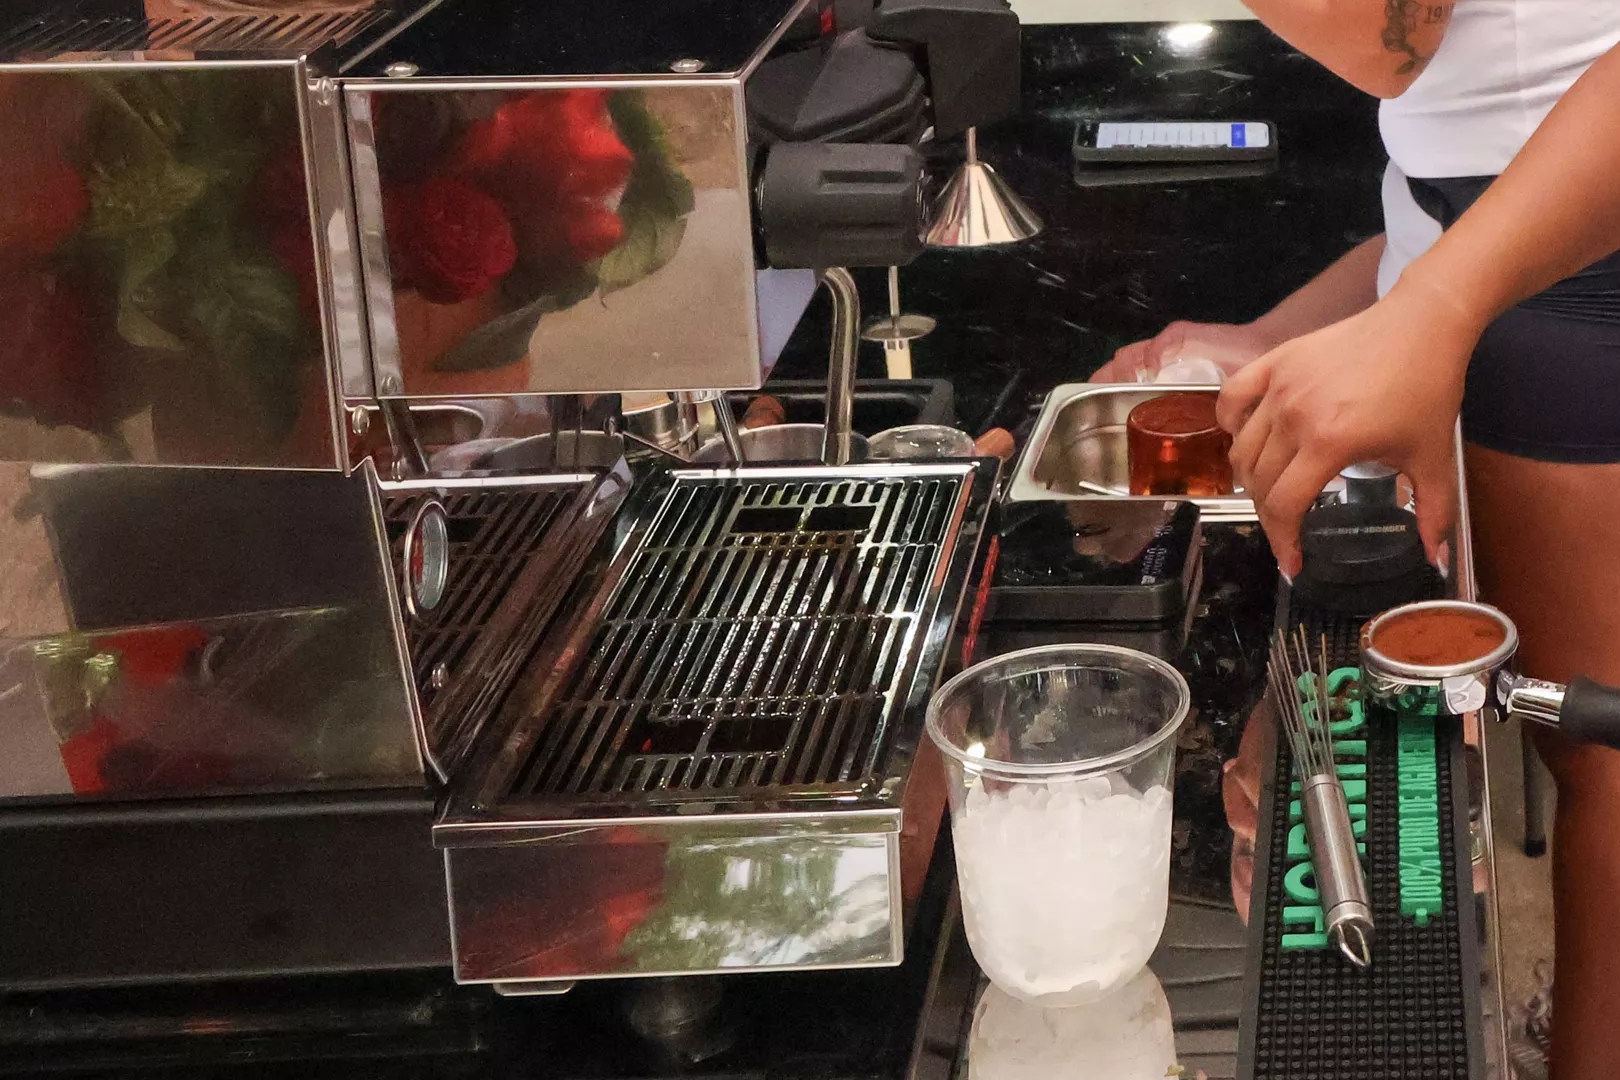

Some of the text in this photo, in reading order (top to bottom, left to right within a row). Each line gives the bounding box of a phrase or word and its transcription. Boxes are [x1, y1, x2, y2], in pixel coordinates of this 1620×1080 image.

[1398, 794, 1438, 813] DE
[1398, 817, 1440, 856] PURO
[1399, 859, 1442, 902] 100%
